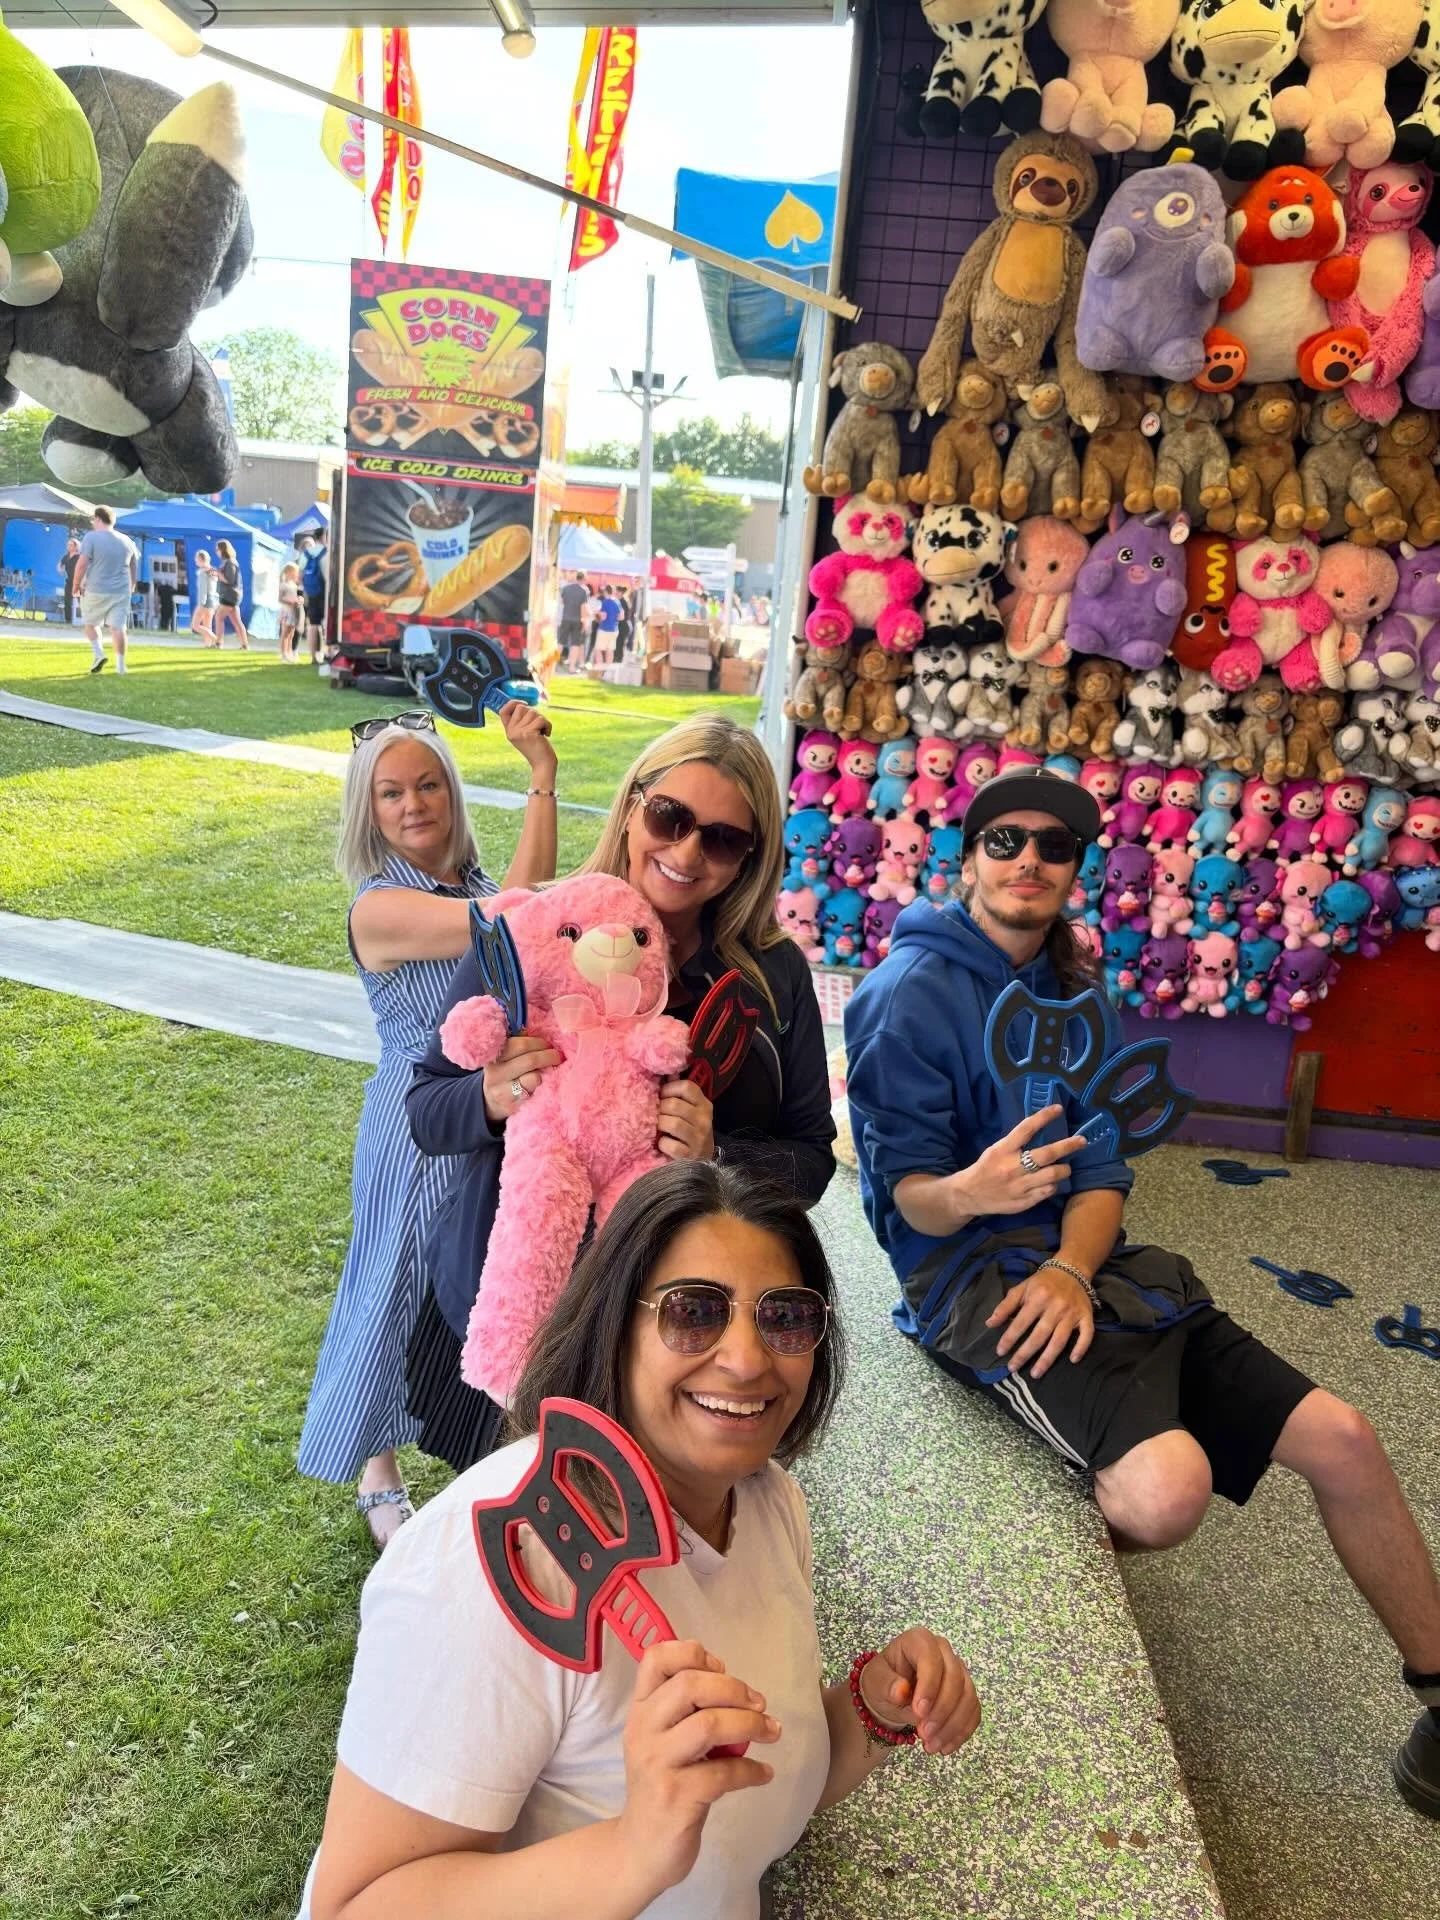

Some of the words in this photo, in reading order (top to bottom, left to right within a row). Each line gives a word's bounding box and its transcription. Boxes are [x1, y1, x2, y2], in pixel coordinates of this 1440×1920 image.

[400, 298, 498, 331] CORN
[407, 322, 489, 351] DOGS
[367, 388, 412, 401] FRESH
[416, 389, 450, 401] AND
[454, 391, 527, 417] DELICIOUS
[362, 458, 393, 472] ICE
[398, 460, 449, 478] COLD
[452, 466, 524, 486] DRINKS
